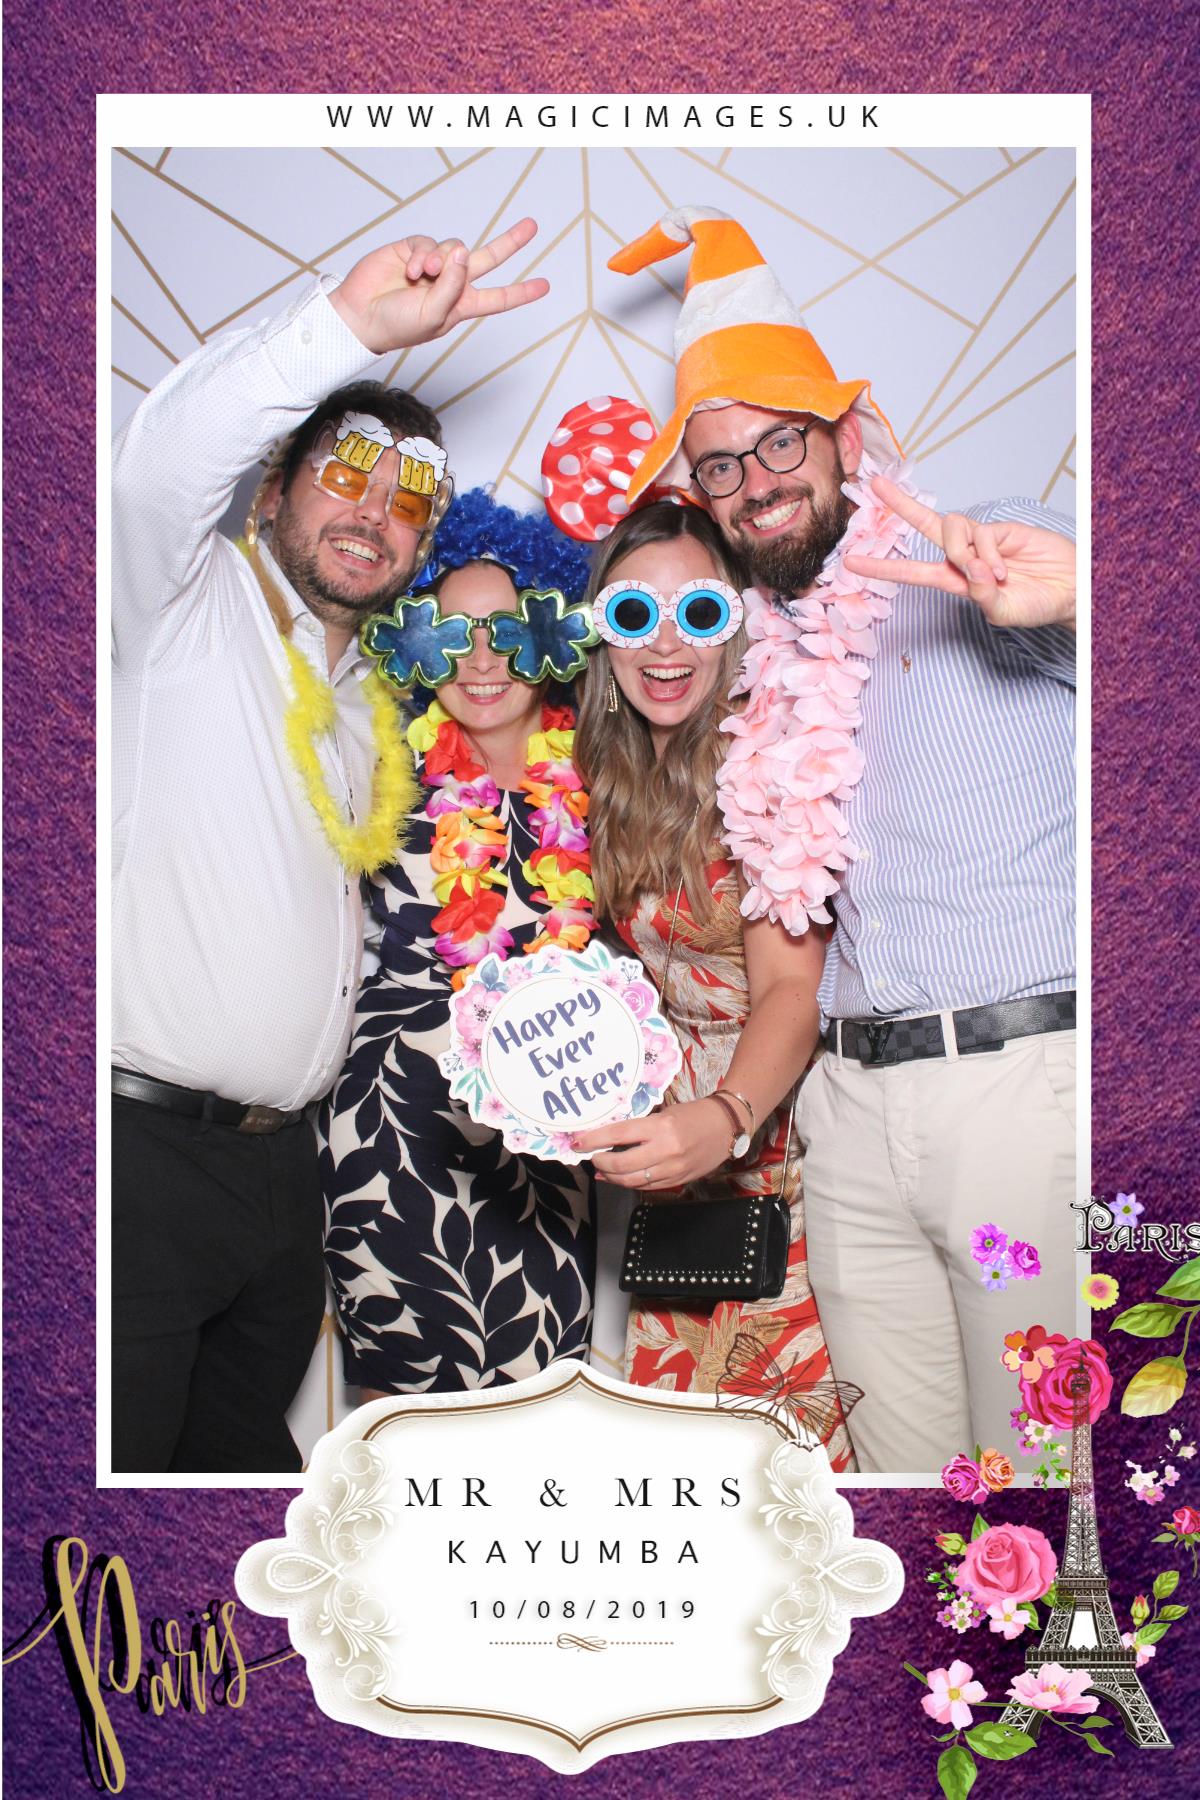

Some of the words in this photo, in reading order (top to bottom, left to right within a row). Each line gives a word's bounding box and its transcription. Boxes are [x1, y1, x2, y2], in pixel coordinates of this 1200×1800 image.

[492, 988, 602, 1054] Happy
[528, 1030, 595, 1079] Ever
[542, 1061, 625, 1121] After
